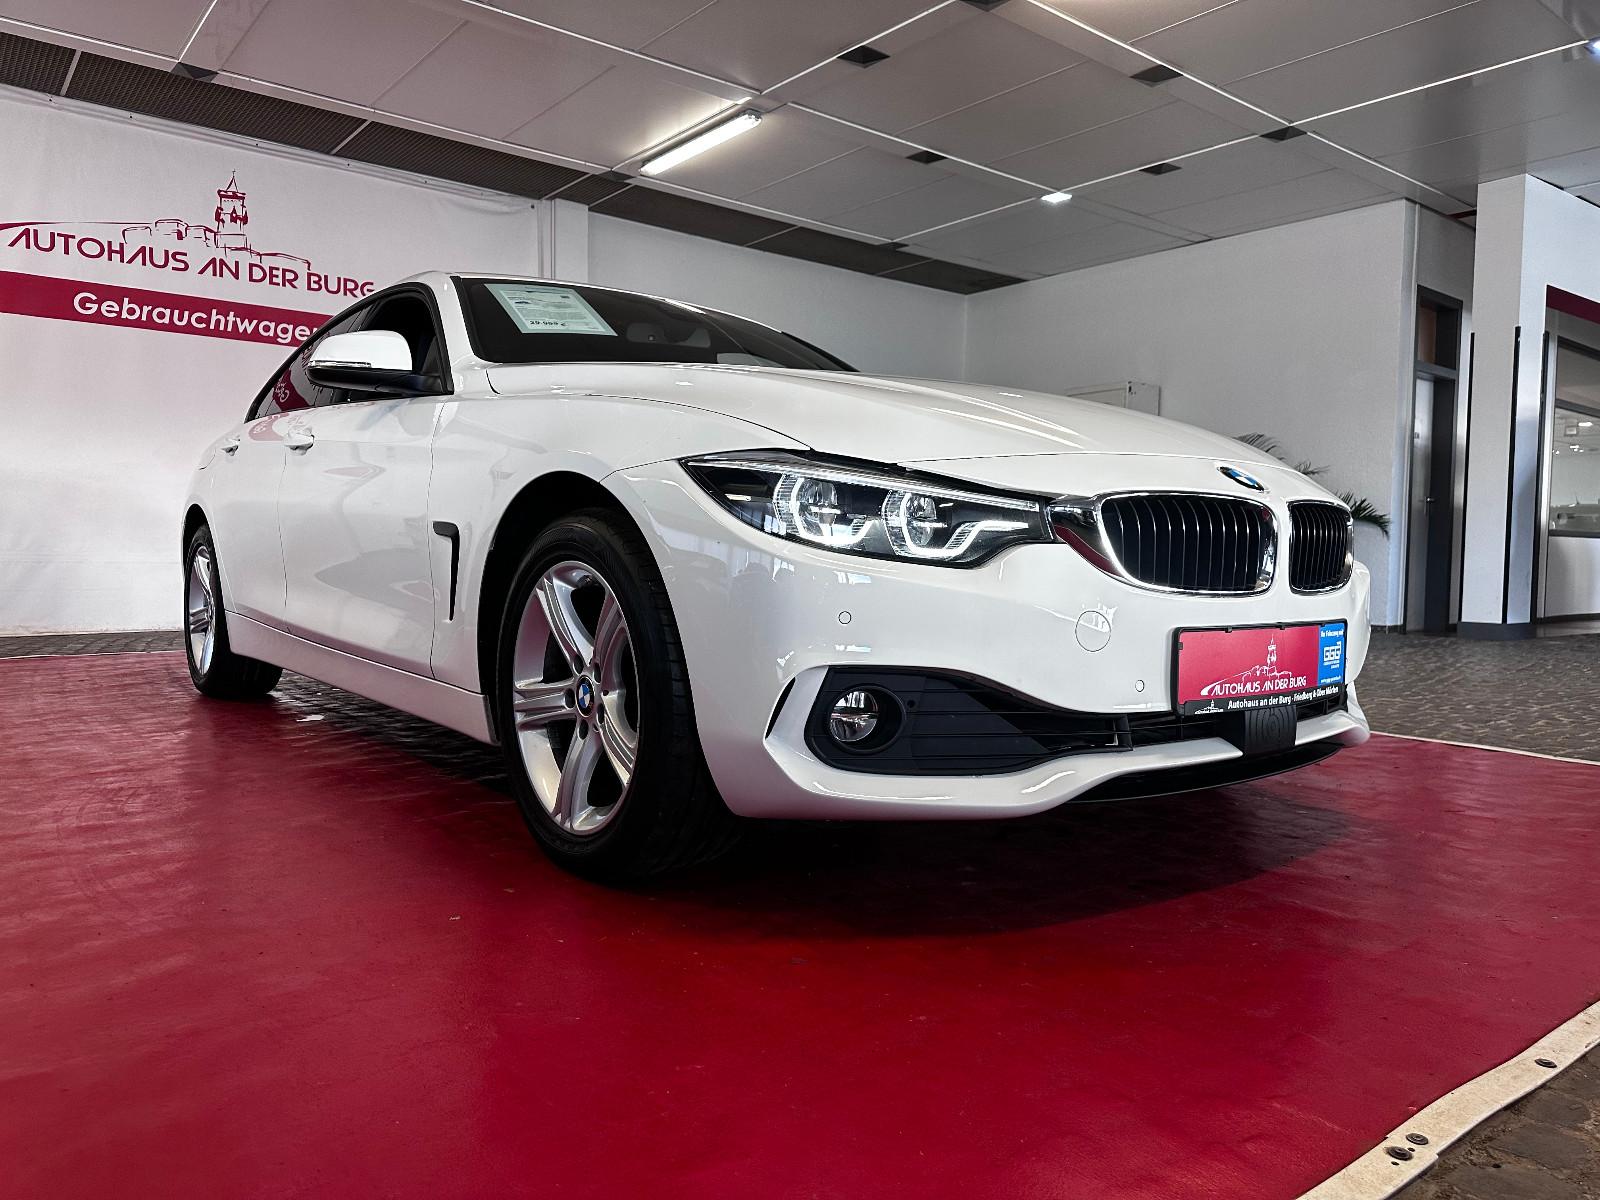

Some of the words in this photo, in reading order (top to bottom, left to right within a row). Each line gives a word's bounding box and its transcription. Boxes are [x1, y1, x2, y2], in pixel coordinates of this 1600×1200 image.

[8, 227, 190, 272] AUTOHAUS
[197, 257, 240, 281] AN
[248, 262, 298, 290] DER
[306, 271, 375, 298] BURG
[73, 291, 317, 344] Gebrauchtwage
[1211, 681, 1261, 696] AUTOHAUS
[1262, 680, 1274, 692] AN
[1275, 678, 1289, 690] DER
[1289, 676, 1306, 688] BURG
[1228, 699, 1259, 709] Autohaus
[1269, 695, 1279, 705] der
[1279, 696, 1292, 705] Burg
